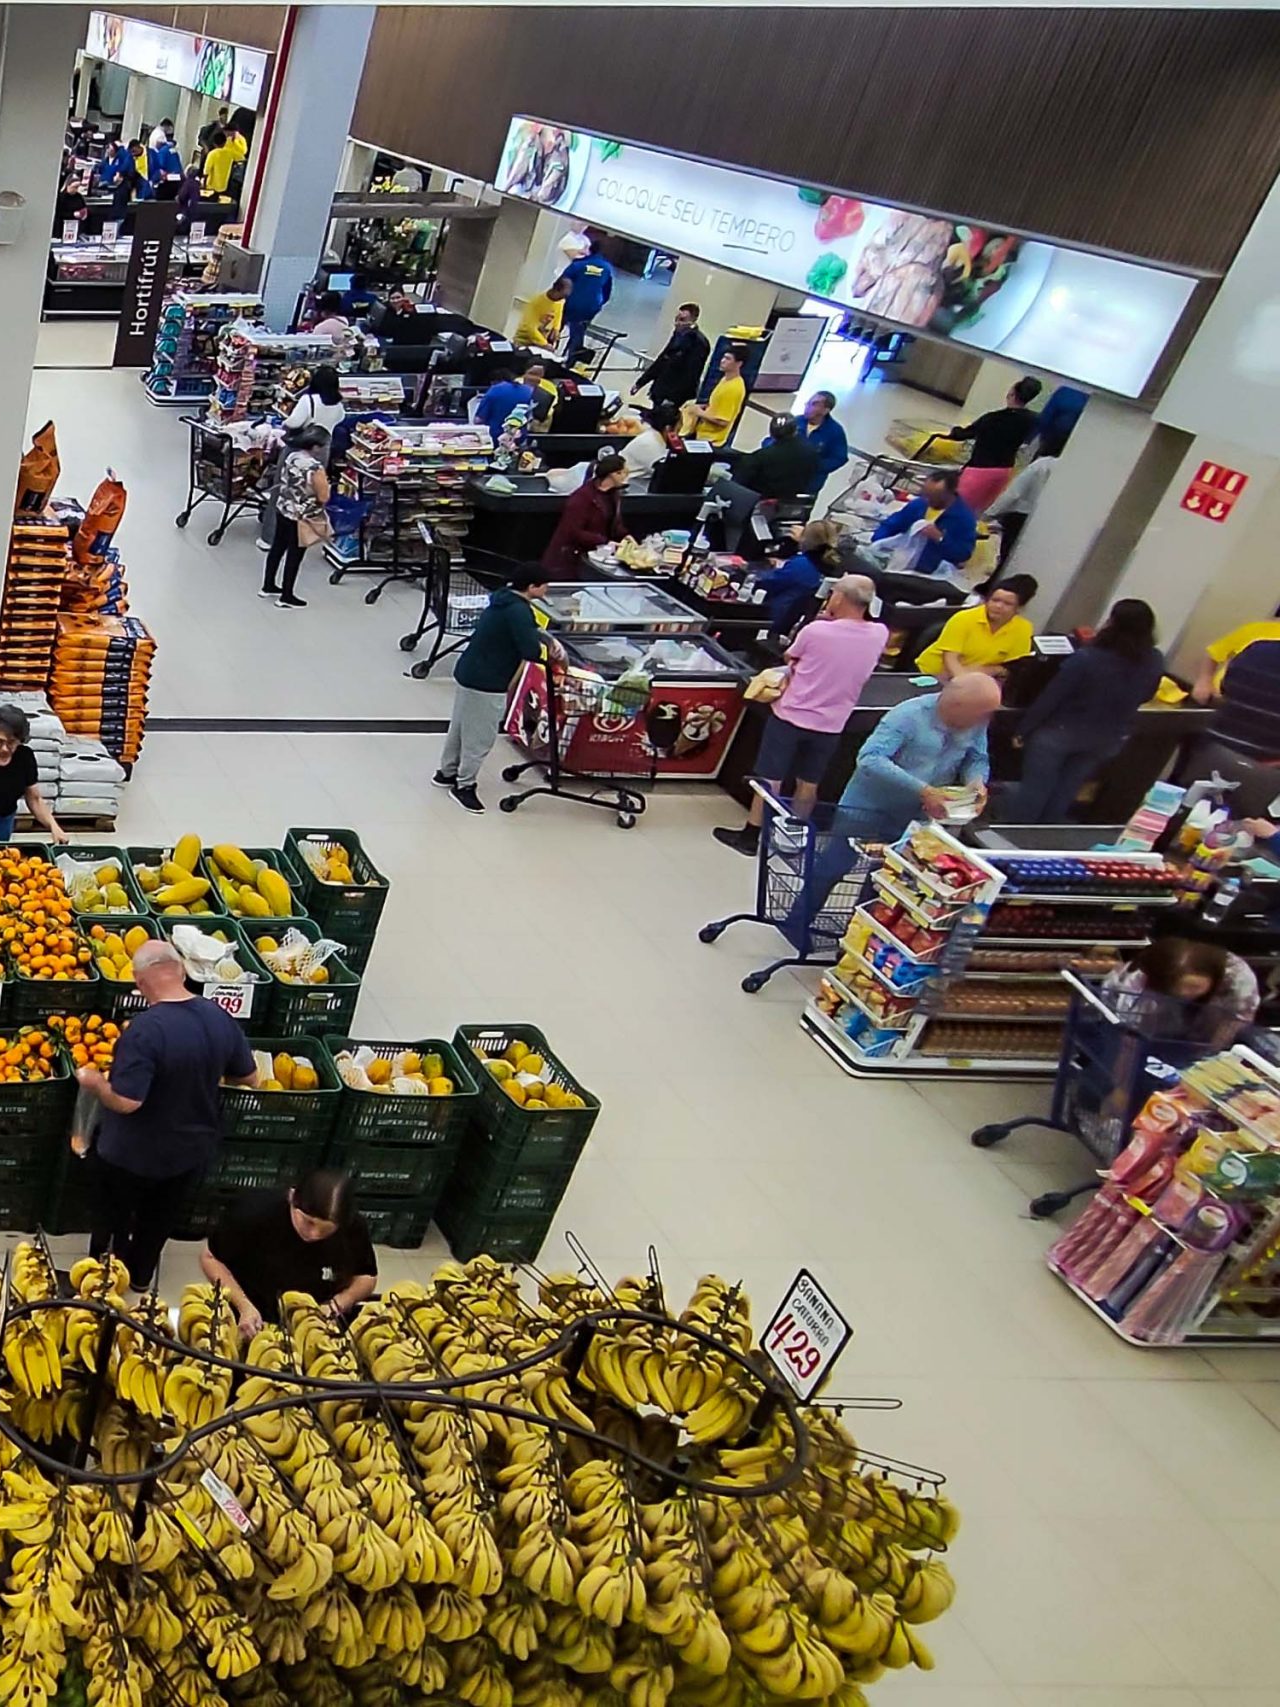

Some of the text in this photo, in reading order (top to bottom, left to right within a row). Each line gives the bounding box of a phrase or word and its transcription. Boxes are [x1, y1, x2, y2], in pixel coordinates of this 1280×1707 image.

[596, 177, 796, 253] COLOQUE SEU TEMPERO
[129, 240, 161, 336] Hortifrúti
[791, 1298, 830, 1347] CATURRA
[797, 1278, 835, 1330] BANANA
